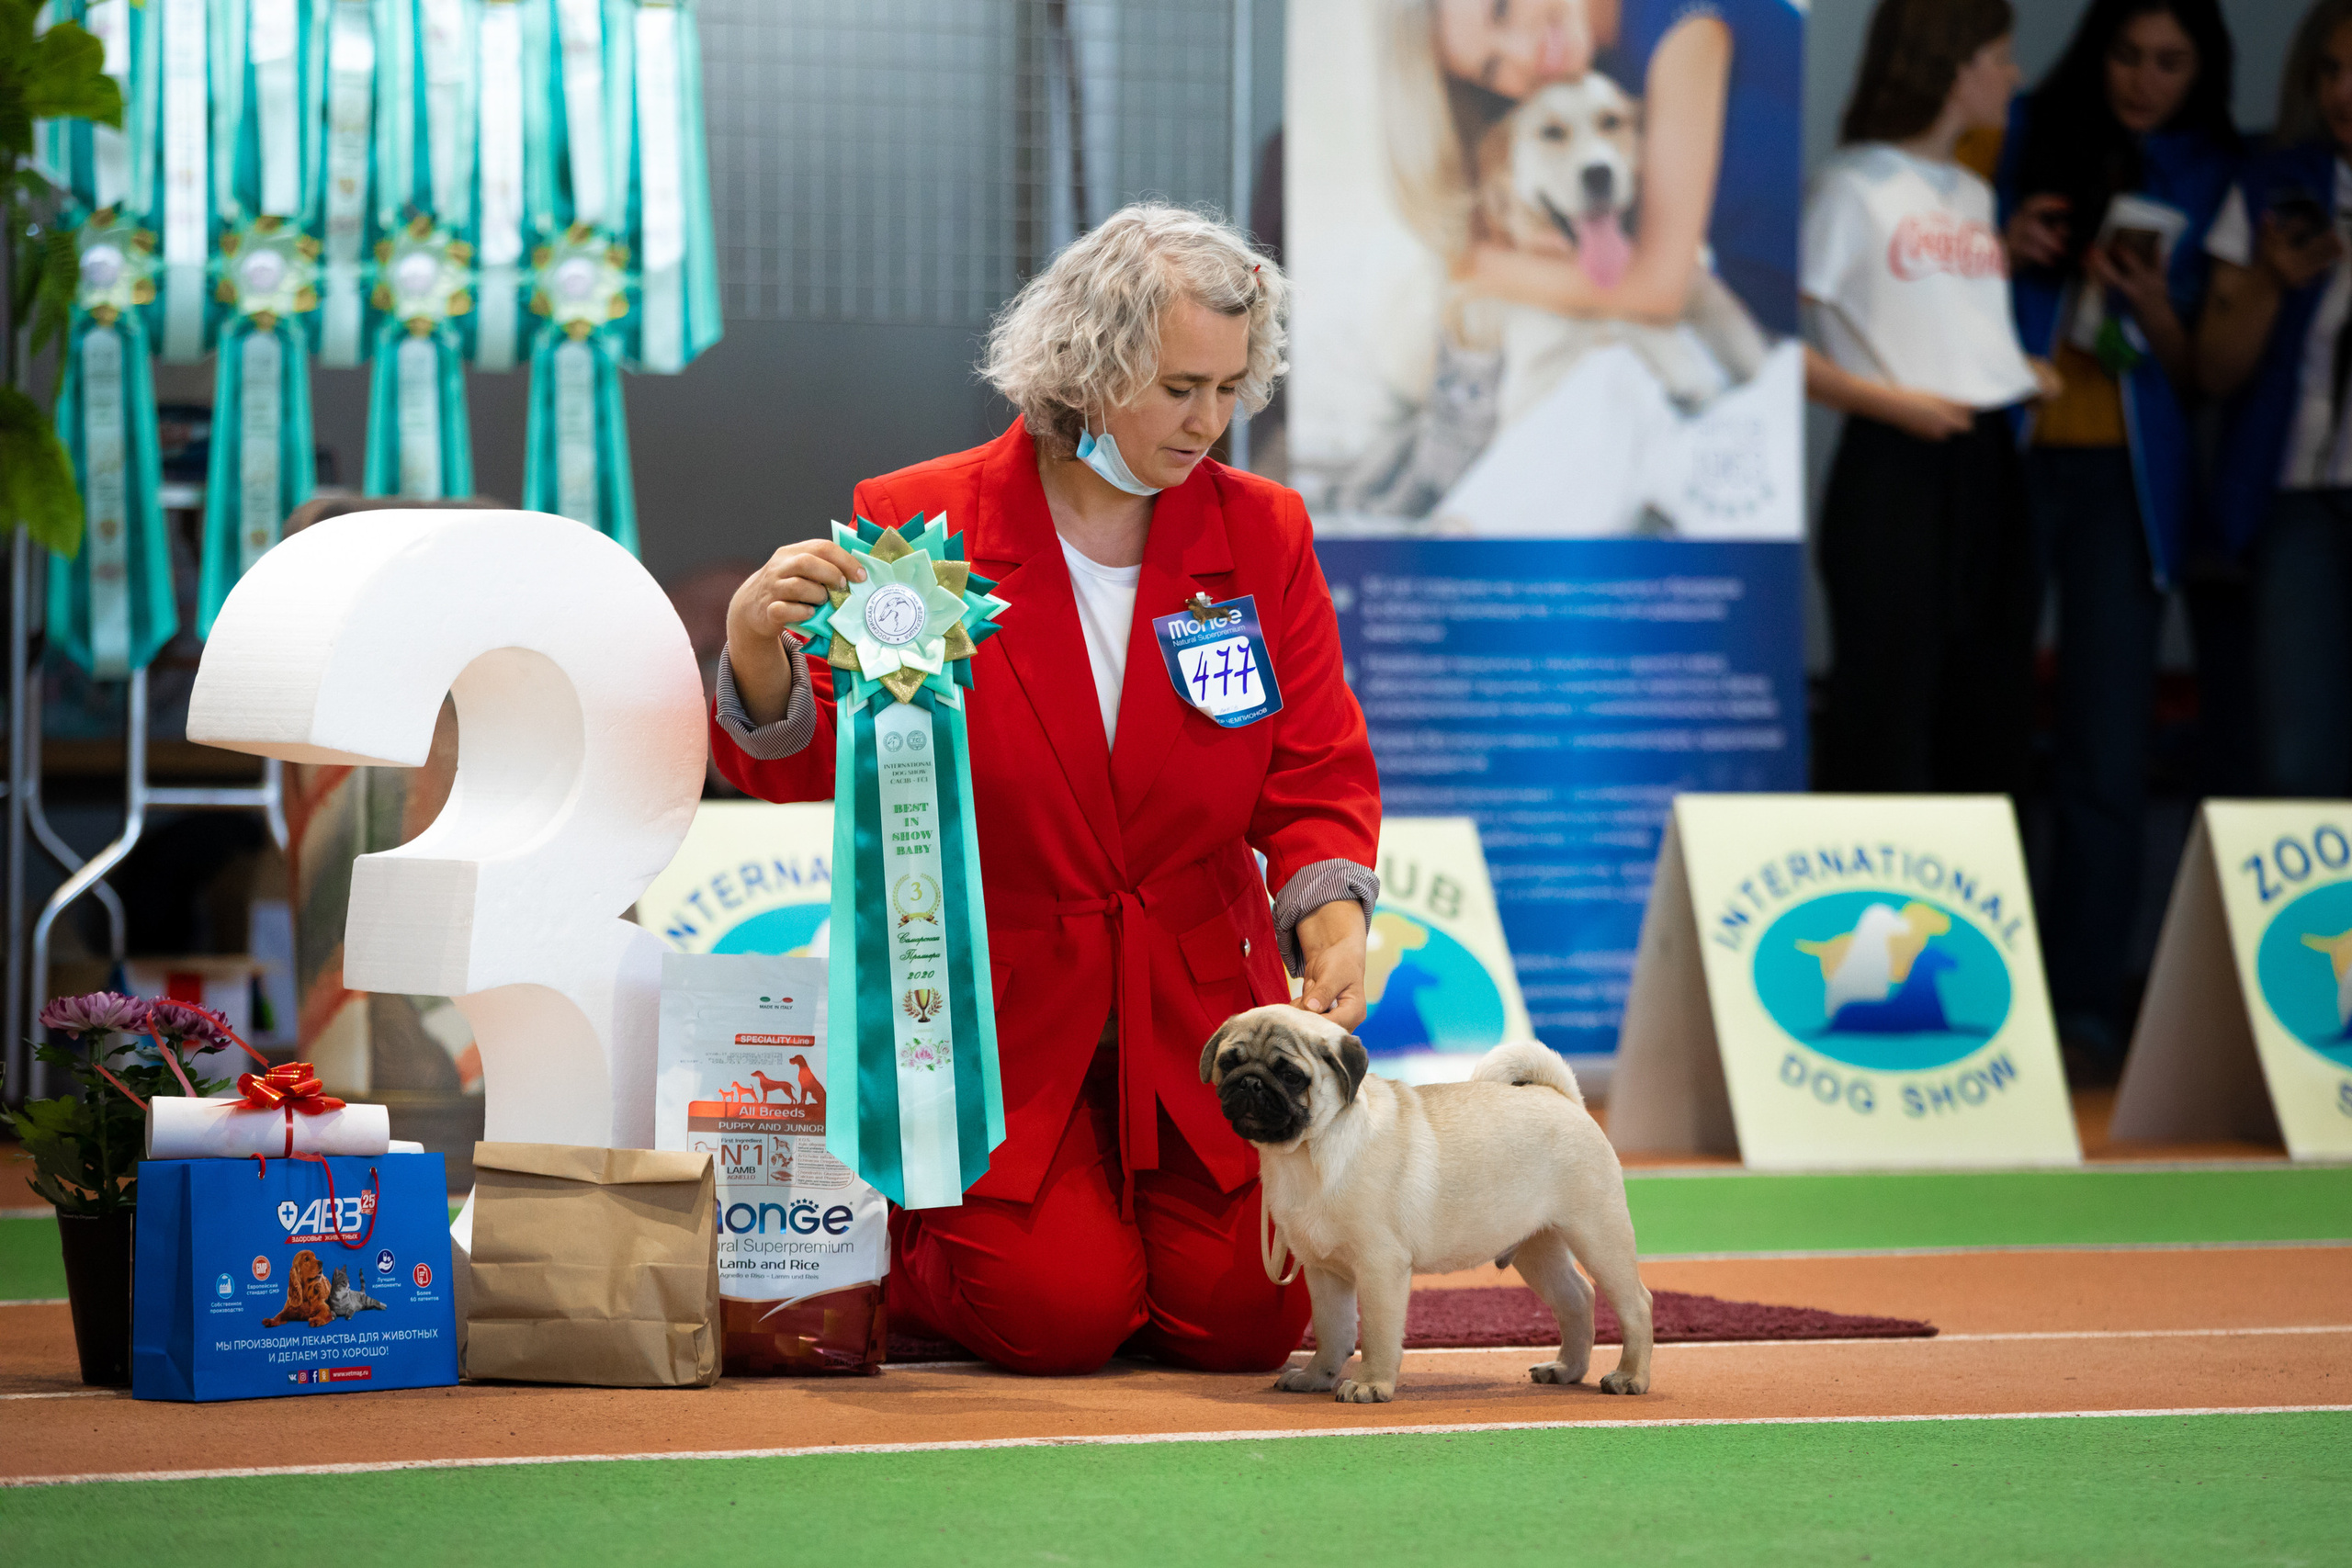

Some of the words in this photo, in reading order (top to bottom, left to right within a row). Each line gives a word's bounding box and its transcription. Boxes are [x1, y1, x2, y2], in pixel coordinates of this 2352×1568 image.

[1172, 637, 1197, 647] Natural
[1197, 625, 1246, 642] Superpremium
[1193, 643, 1257, 701] 477
[893, 802, 929, 813] BEST
[904, 817, 919, 827] IN
[892, 830, 933, 841] SHOW
[896, 844, 932, 856] BABY
[910, 881, 922, 902] 3
[1712, 844, 2022, 952] INTERNATIONAL
[907, 970, 935, 980] 2020
[741, 1035, 792, 1044] SPECIALITY
[1779, 1054, 1875, 1114] DOG
[1902, 1054, 2018, 1119] SHOW
[739, 1106, 755, 1116] All
[759, 1107, 805, 1118] Breeds
[719, 1122, 755, 1130] PUPPY
[784, 1124, 824, 1133] JUNIOR
[362, 1194, 375, 1209] 25
[744, 1238, 854, 1256] Superpremium
[720, 1258, 756, 1269] Lamb
[760, 1259, 786, 1270] and
[790, 1260, 820, 1271] Rice
[216, 1341, 232, 1351] МЫ
[234, 1337, 300, 1350] ПРОИЗВОДИМ
[302, 1333, 357, 1346] ЛЕКАРСТВА
[359, 1332, 379, 1344] ДЛЯ
[381, 1329, 439, 1341] ЖИВОТНЫХ
[269, 1353, 275, 1363] И
[278, 1350, 318, 1364] ДЕЛАЕМ
[320, 1349, 339, 1359] ЭТО
[342, 1346, 389, 1358] ХОРОШО!
